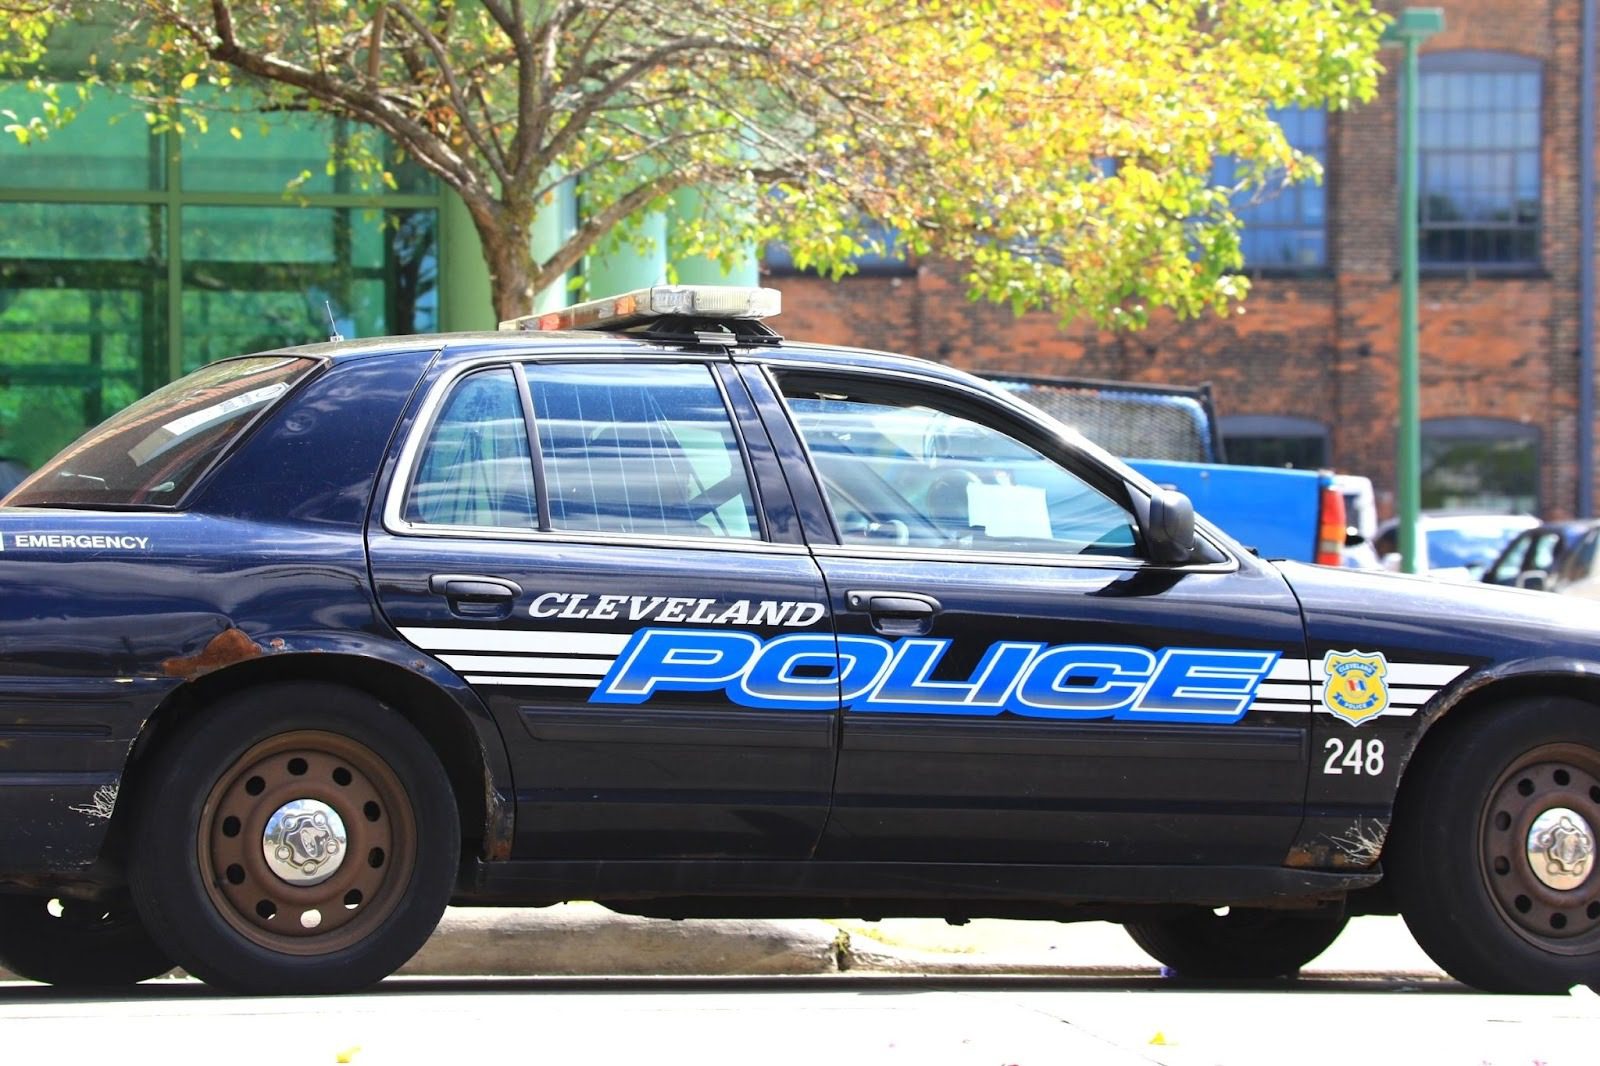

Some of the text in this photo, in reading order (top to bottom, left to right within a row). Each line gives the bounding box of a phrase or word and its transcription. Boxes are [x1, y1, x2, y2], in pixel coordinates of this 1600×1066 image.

[15, 534, 149, 549] EMERGENCY
[528, 592, 825, 627] CLEVELAND
[588, 627, 1283, 724] POLICE
[1338, 662, 1373, 674] CLEVELAND
[1344, 702, 1368, 710] POLICE
[1323, 737, 1385, 776] 248
